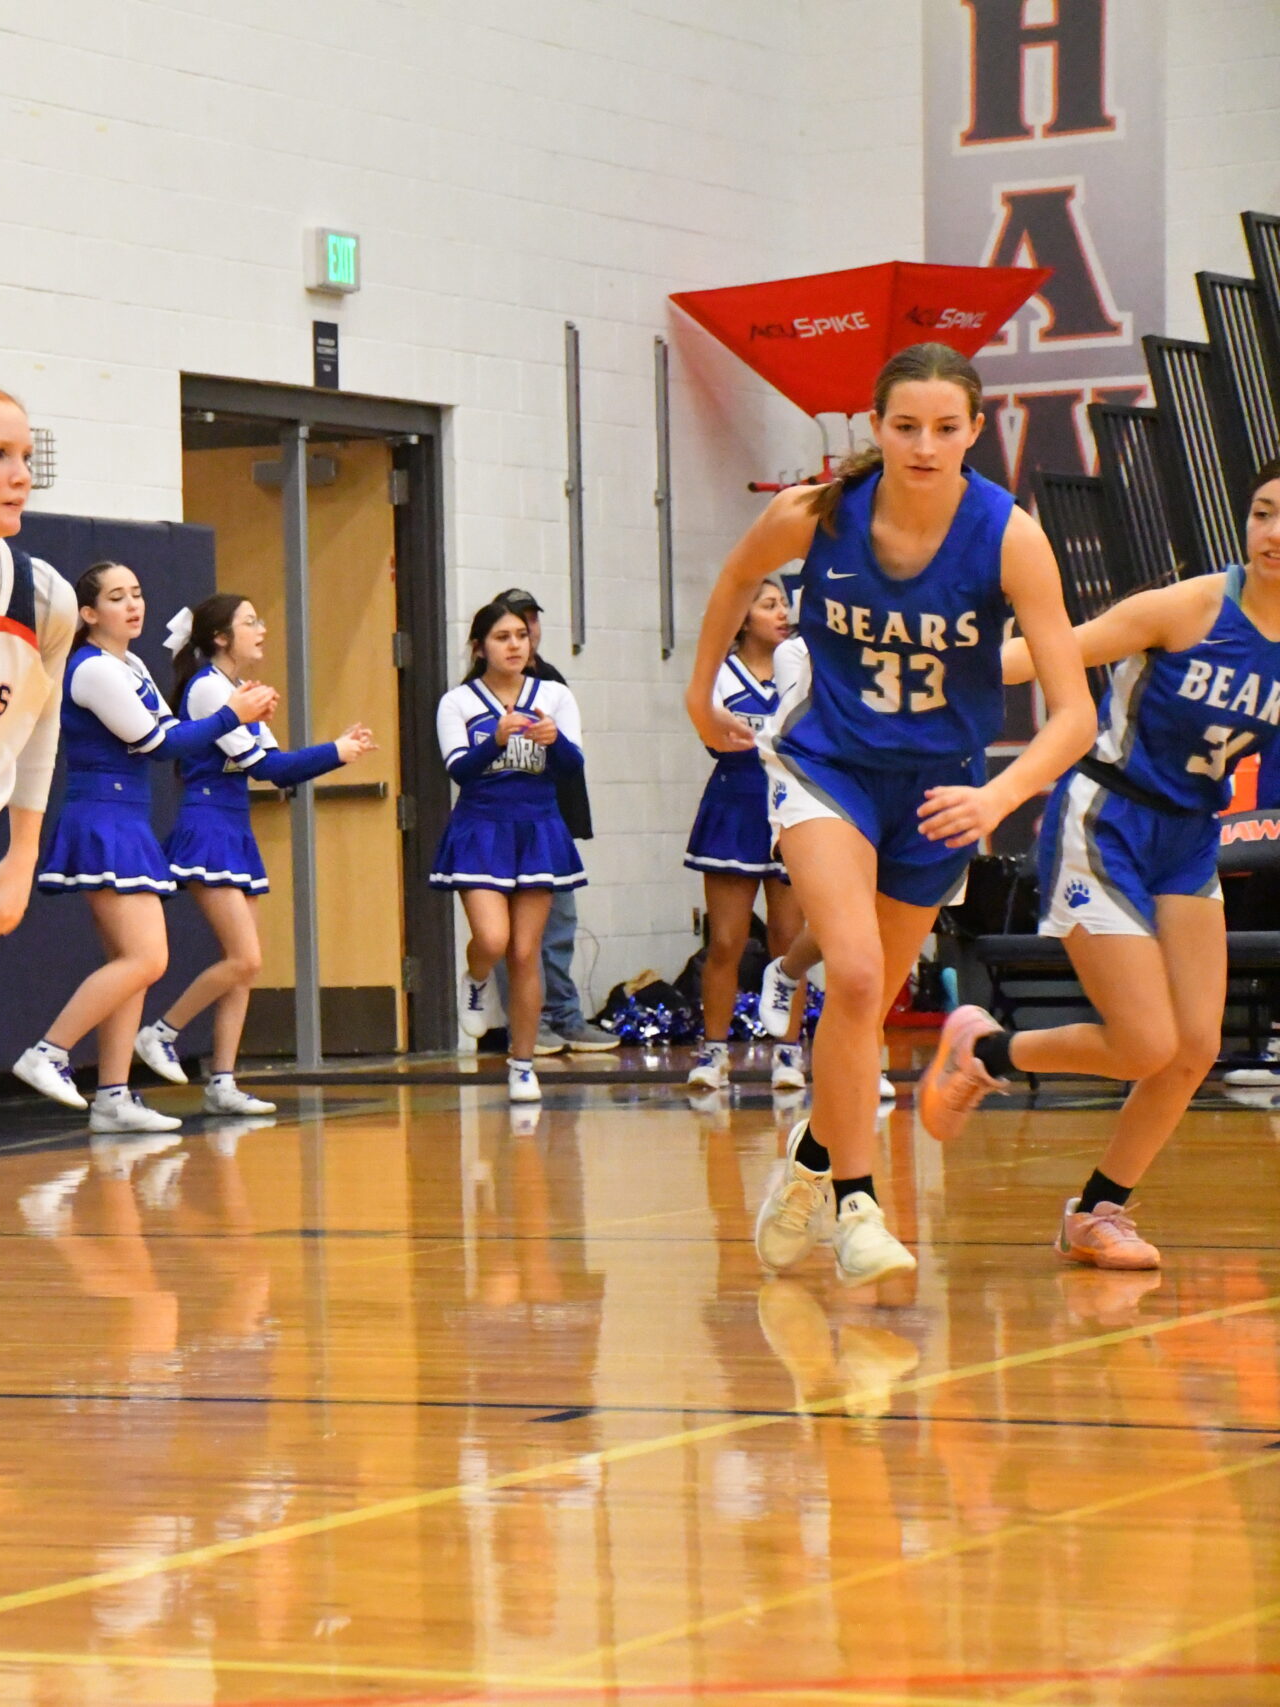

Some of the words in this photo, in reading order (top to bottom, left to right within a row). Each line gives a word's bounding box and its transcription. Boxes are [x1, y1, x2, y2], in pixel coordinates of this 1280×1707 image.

[328, 233, 357, 285] EXIT
[824, 598, 979, 651] BEARS
[861, 647, 947, 713] 33
